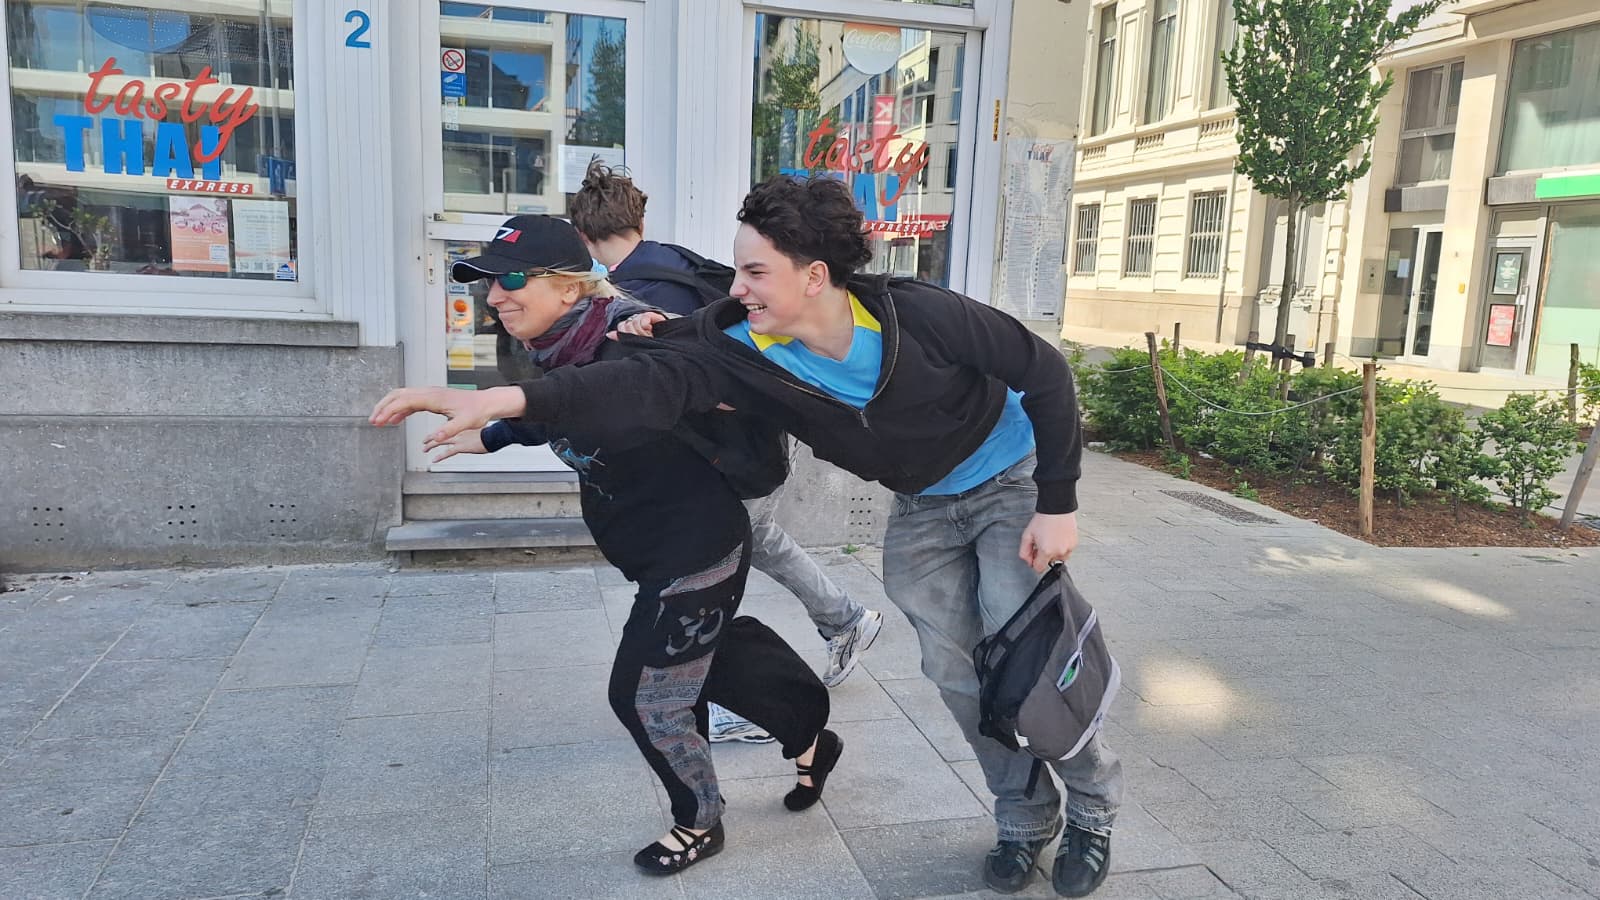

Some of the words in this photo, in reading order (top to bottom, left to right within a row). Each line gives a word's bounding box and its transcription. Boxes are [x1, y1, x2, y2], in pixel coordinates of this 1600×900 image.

[345, 10, 371, 48] 2
[84, 57, 259, 163] tasty
[53, 115, 222, 181] THAI
[803, 118, 931, 207] tasty
[170, 180, 250, 194] EXPRESS
[779, 167, 899, 222] AI
